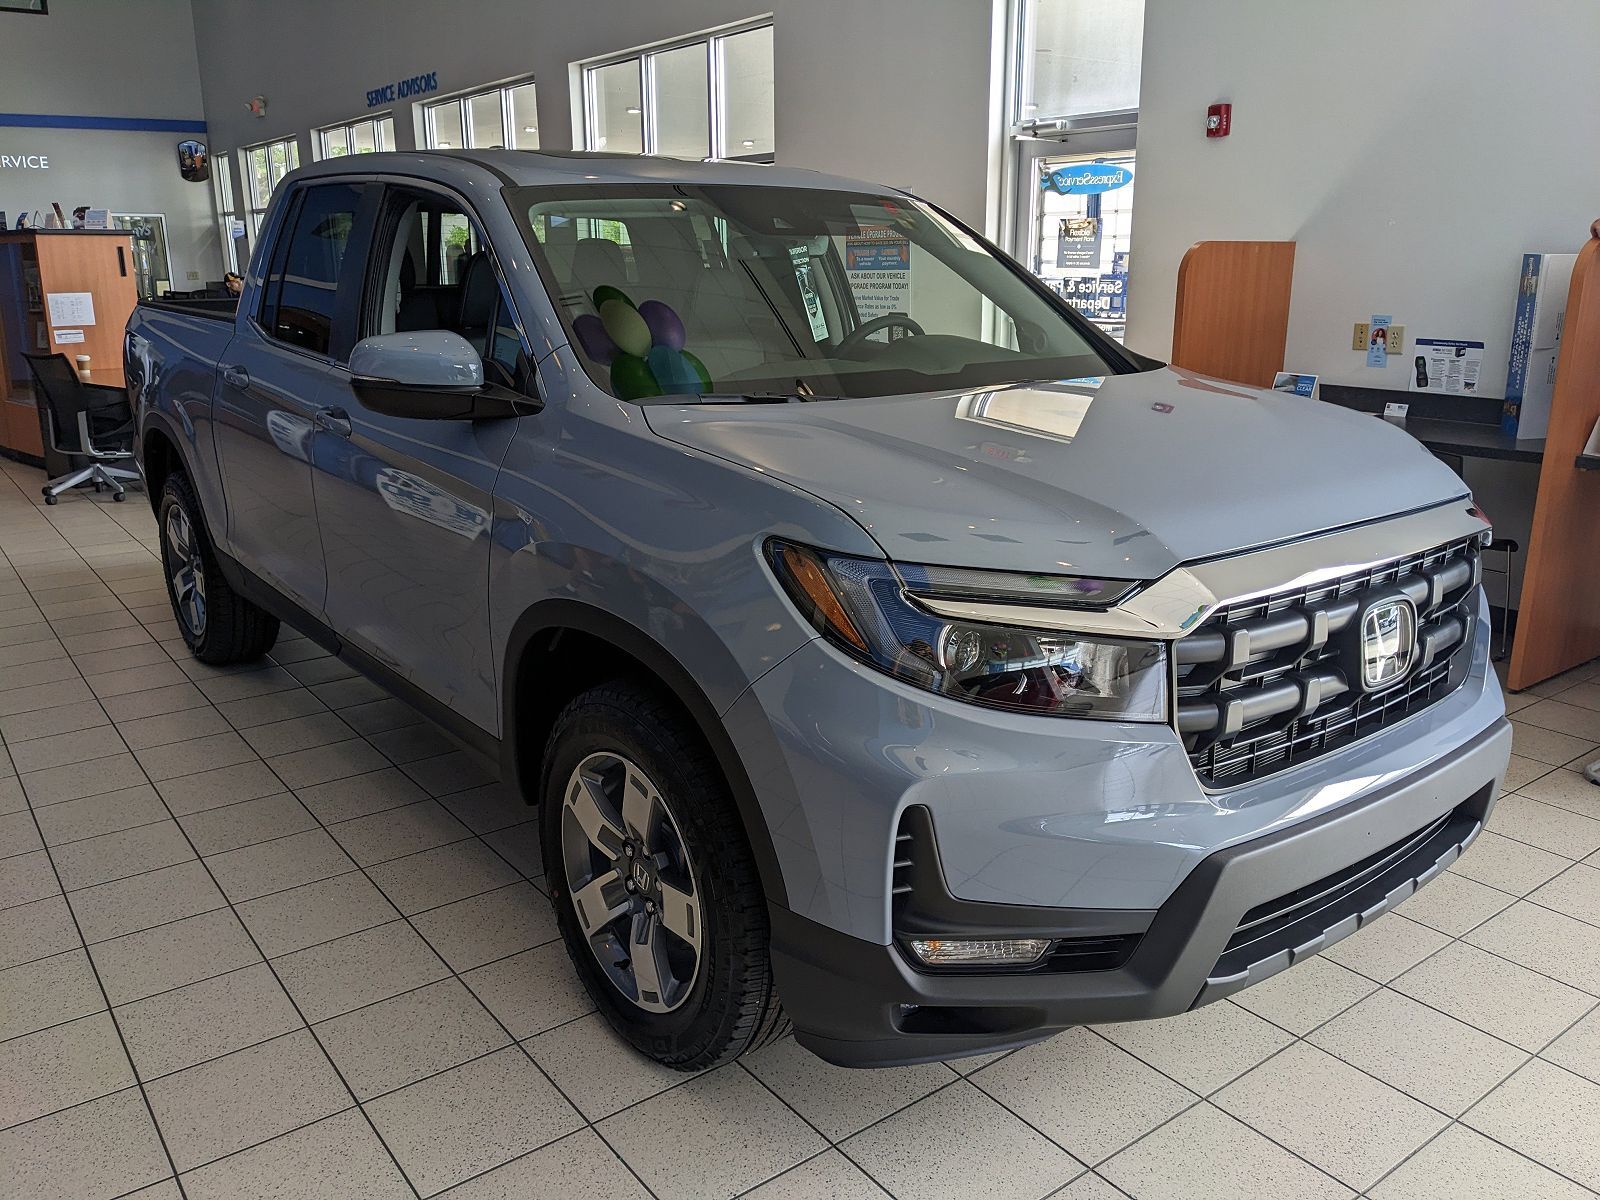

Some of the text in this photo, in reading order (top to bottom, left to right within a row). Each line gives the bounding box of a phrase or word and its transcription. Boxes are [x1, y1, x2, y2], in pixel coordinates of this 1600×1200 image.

[366, 71, 438, 108] SERVICE ADVISORS
[0, 155, 49, 169] RVICE
[850, 272, 860, 280] ASK
[861, 272, 876, 280] ABOUT
[869, 282, 892, 290] PROGRAM
[892, 282, 909, 290] TODAY!
